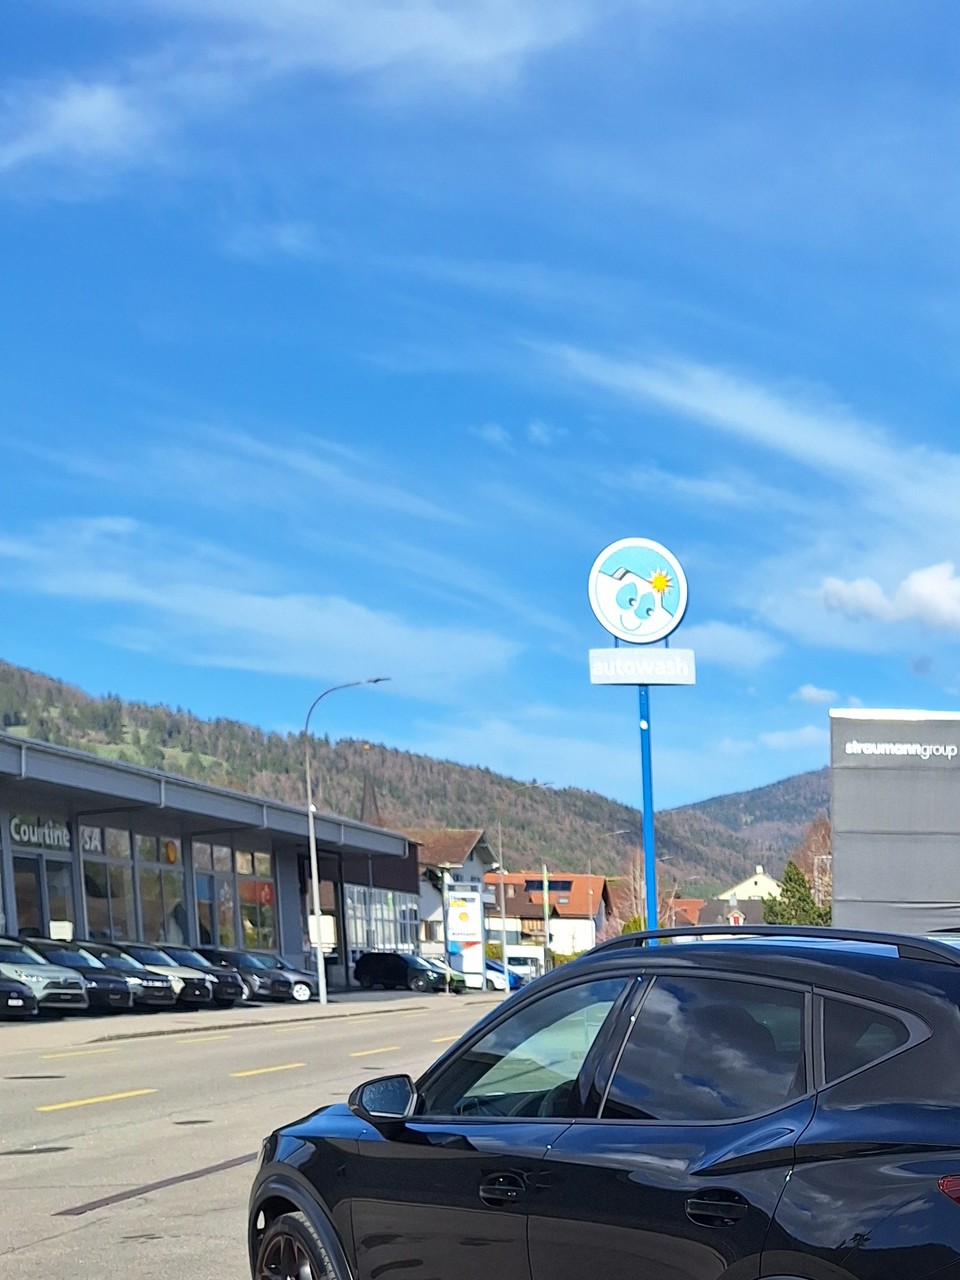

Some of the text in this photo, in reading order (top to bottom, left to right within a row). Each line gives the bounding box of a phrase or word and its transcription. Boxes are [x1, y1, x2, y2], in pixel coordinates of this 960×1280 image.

[592, 658, 689, 677] autowash
[10, 817, 101, 851] Courtine SA
